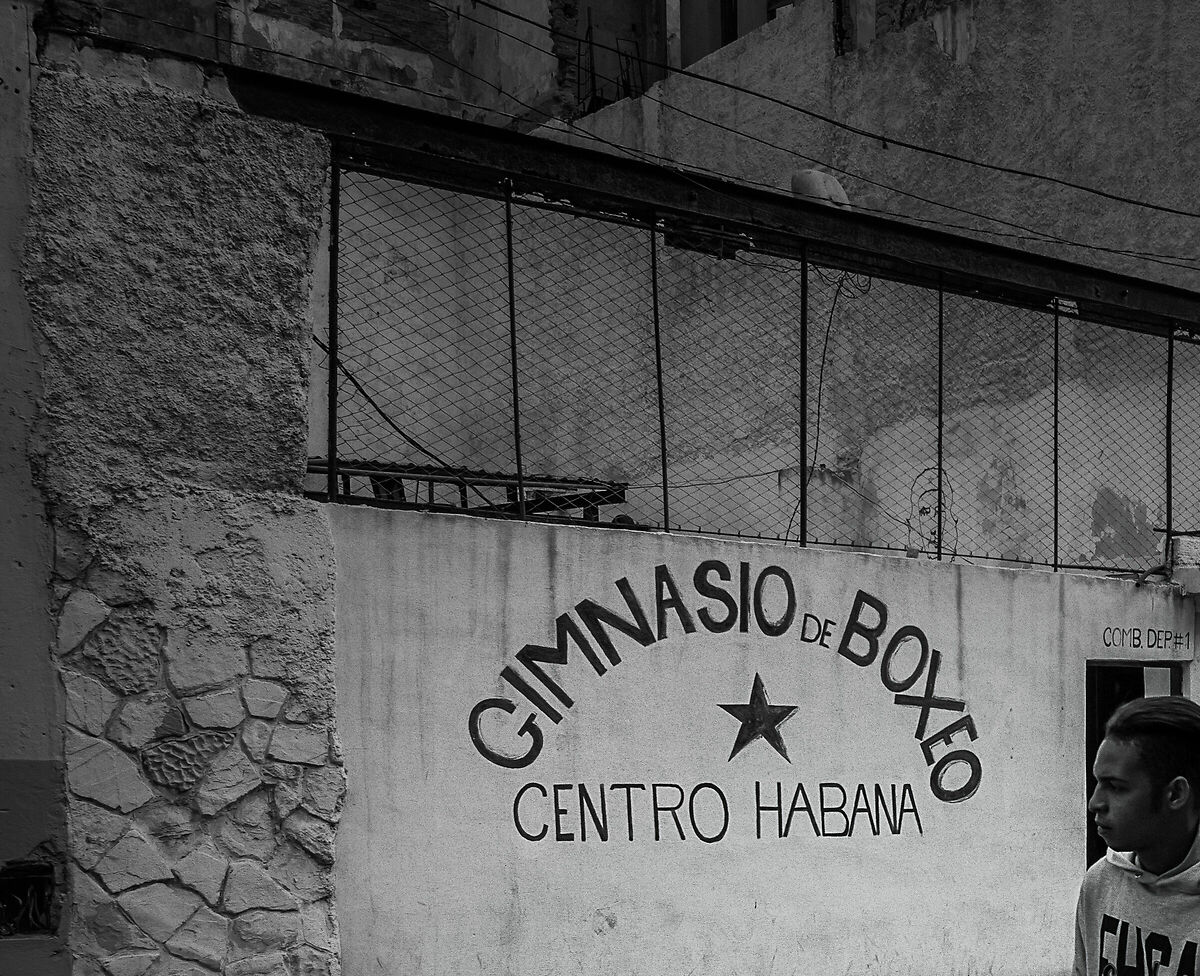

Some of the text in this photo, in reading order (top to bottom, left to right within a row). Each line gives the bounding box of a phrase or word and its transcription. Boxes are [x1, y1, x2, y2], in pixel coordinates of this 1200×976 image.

[1102, 626, 1143, 649] COMB.
[468, 559, 983, 803] GIMNASIO DE BOXEO
[513, 780, 924, 844] CENTRO HABANA
